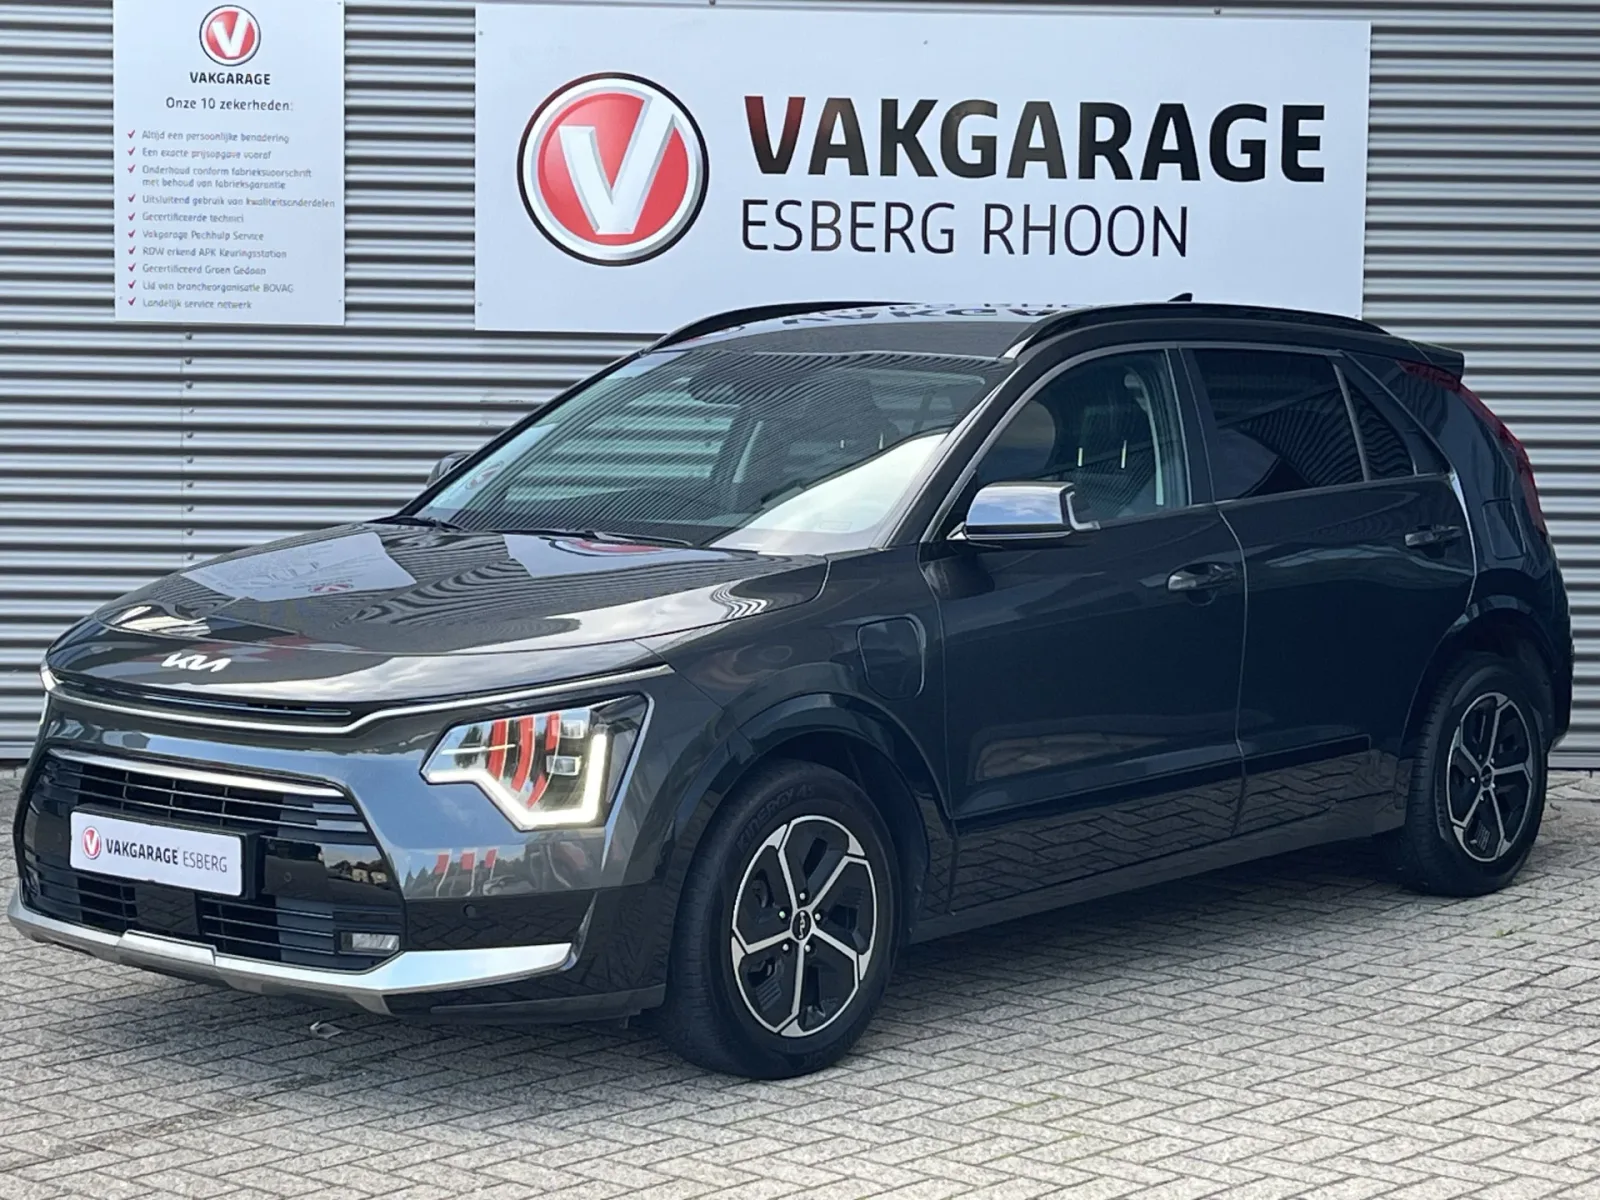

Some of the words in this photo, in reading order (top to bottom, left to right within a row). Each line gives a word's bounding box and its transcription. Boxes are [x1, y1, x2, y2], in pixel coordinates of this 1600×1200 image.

[190, 72, 271, 85] VAKGARAGE
[166, 97, 197, 109] Onze
[201, 98, 216, 110] 10
[219, 98, 294, 111] zekerheden:
[142, 130, 165, 141] Altijd
[168, 132, 184, 140] een
[186, 131, 238, 143] persoonlijke
[241, 132, 290, 144] benadering
[744, 95, 1326, 184] VAKGARAGE
[142, 147, 158, 157] Een
[161, 149, 189, 158] exacte
[191, 148, 241, 160] prijsopgave
[243, 150, 272, 160] vooraf
[142, 165, 190, 176] Onderhoud
[193, 167, 229, 177] conform
[231, 167, 312, 178] fabrieksvoorschrift
[142, 179, 160, 188] met
[162, 179, 194, 188] behoud
[215, 180, 286, 190] fabrieksgarantie
[142, 195, 190, 204] Uitsluitend
[193, 196, 225, 207] gebruik
[227, 198, 244, 206] van
[210, 214, 244, 223] technici
[741, 199, 955, 254] ESBERG
[983, 204, 1188, 258] RHOON
[142, 230, 188, 240] Vakgarage
[232, 231, 264, 241] Service
[142, 247, 165, 256] RDW
[167, 248, 196, 257] erkend
[198, 248, 217, 257] APK
[219, 249, 287, 260] Keuringsstation
[204, 265, 231, 275] Groen
[233, 266, 266, 276] Gedaan
[142, 282, 156, 291] Lid
[158, 283, 175, 291] van
[263, 284, 294, 293] BOVAG
[142, 299, 182, 309] Landelijk
[184, 301, 215, 310] service
[217, 301, 252, 310] netwerk
[106, 838, 178, 865] VAKGARAGE
[183, 851, 227, 873] ESBERG
